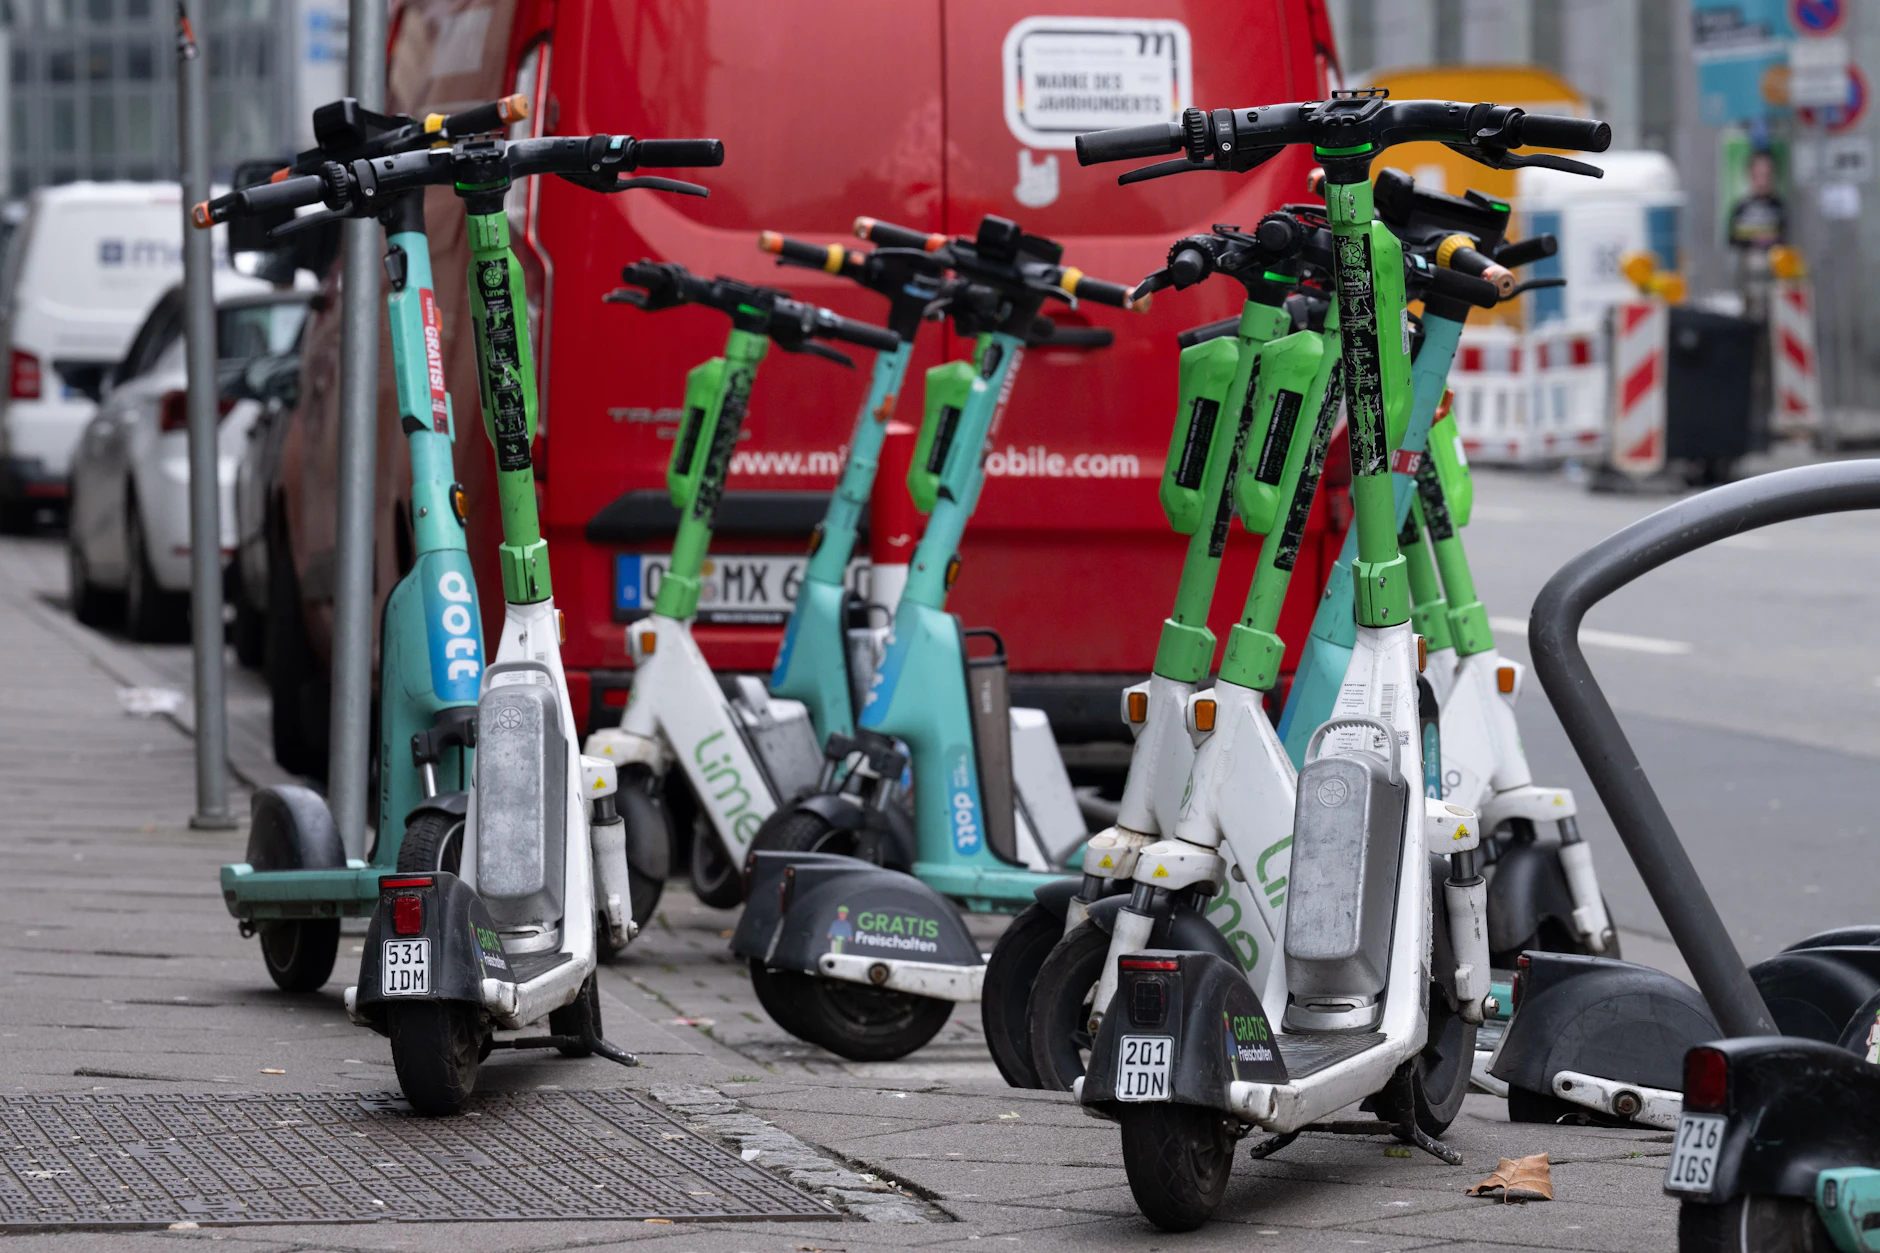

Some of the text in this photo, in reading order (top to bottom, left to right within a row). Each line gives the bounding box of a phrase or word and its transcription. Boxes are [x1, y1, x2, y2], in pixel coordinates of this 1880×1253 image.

[425, 325, 444, 391] GRATIS!
[723, 564, 768, 602] MX
[438, 571, 479, 680] dott
[694, 729, 765, 845] Lime
[954, 792, 977, 848] dott
[857, 911, 939, 938] GRATIS
[476, 927, 501, 952] GRATIS
[855, 931, 937, 953] Freischalten
[388, 943, 425, 966] 531
[389, 969, 425, 991] IDM
[1233, 1016, 1268, 1042] GRATIS
[1125, 1042, 1166, 1066] 201
[1238, 1044, 1273, 1062] Freischalten
[1123, 1072, 1165, 1096] IDN
[1681, 1121, 1718, 1149] 716
[1674, 1154, 1712, 1184] IGS
